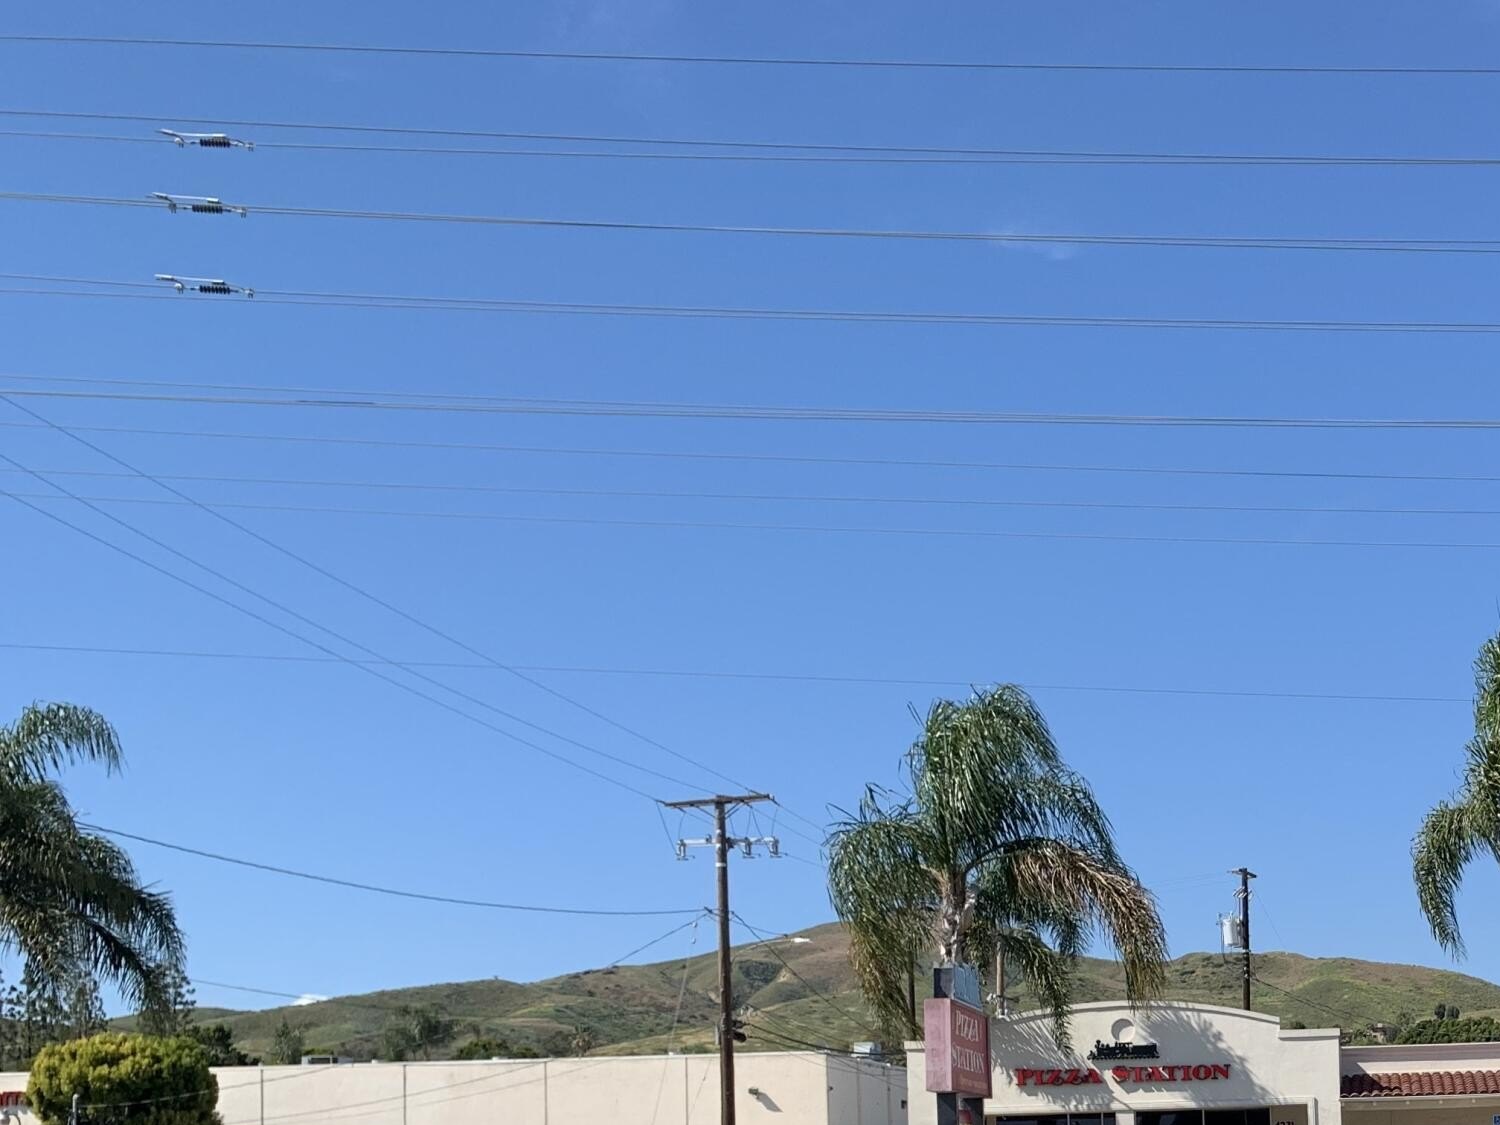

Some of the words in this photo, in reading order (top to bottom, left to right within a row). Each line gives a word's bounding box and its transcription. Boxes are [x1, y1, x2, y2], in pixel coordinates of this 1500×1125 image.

[955, 1009, 979, 1043] PIZZA
[951, 1043, 985, 1073] STATION
[1015, 1067, 1104, 1087] PIZZA
[1111, 1064, 1231, 1084] STATION
